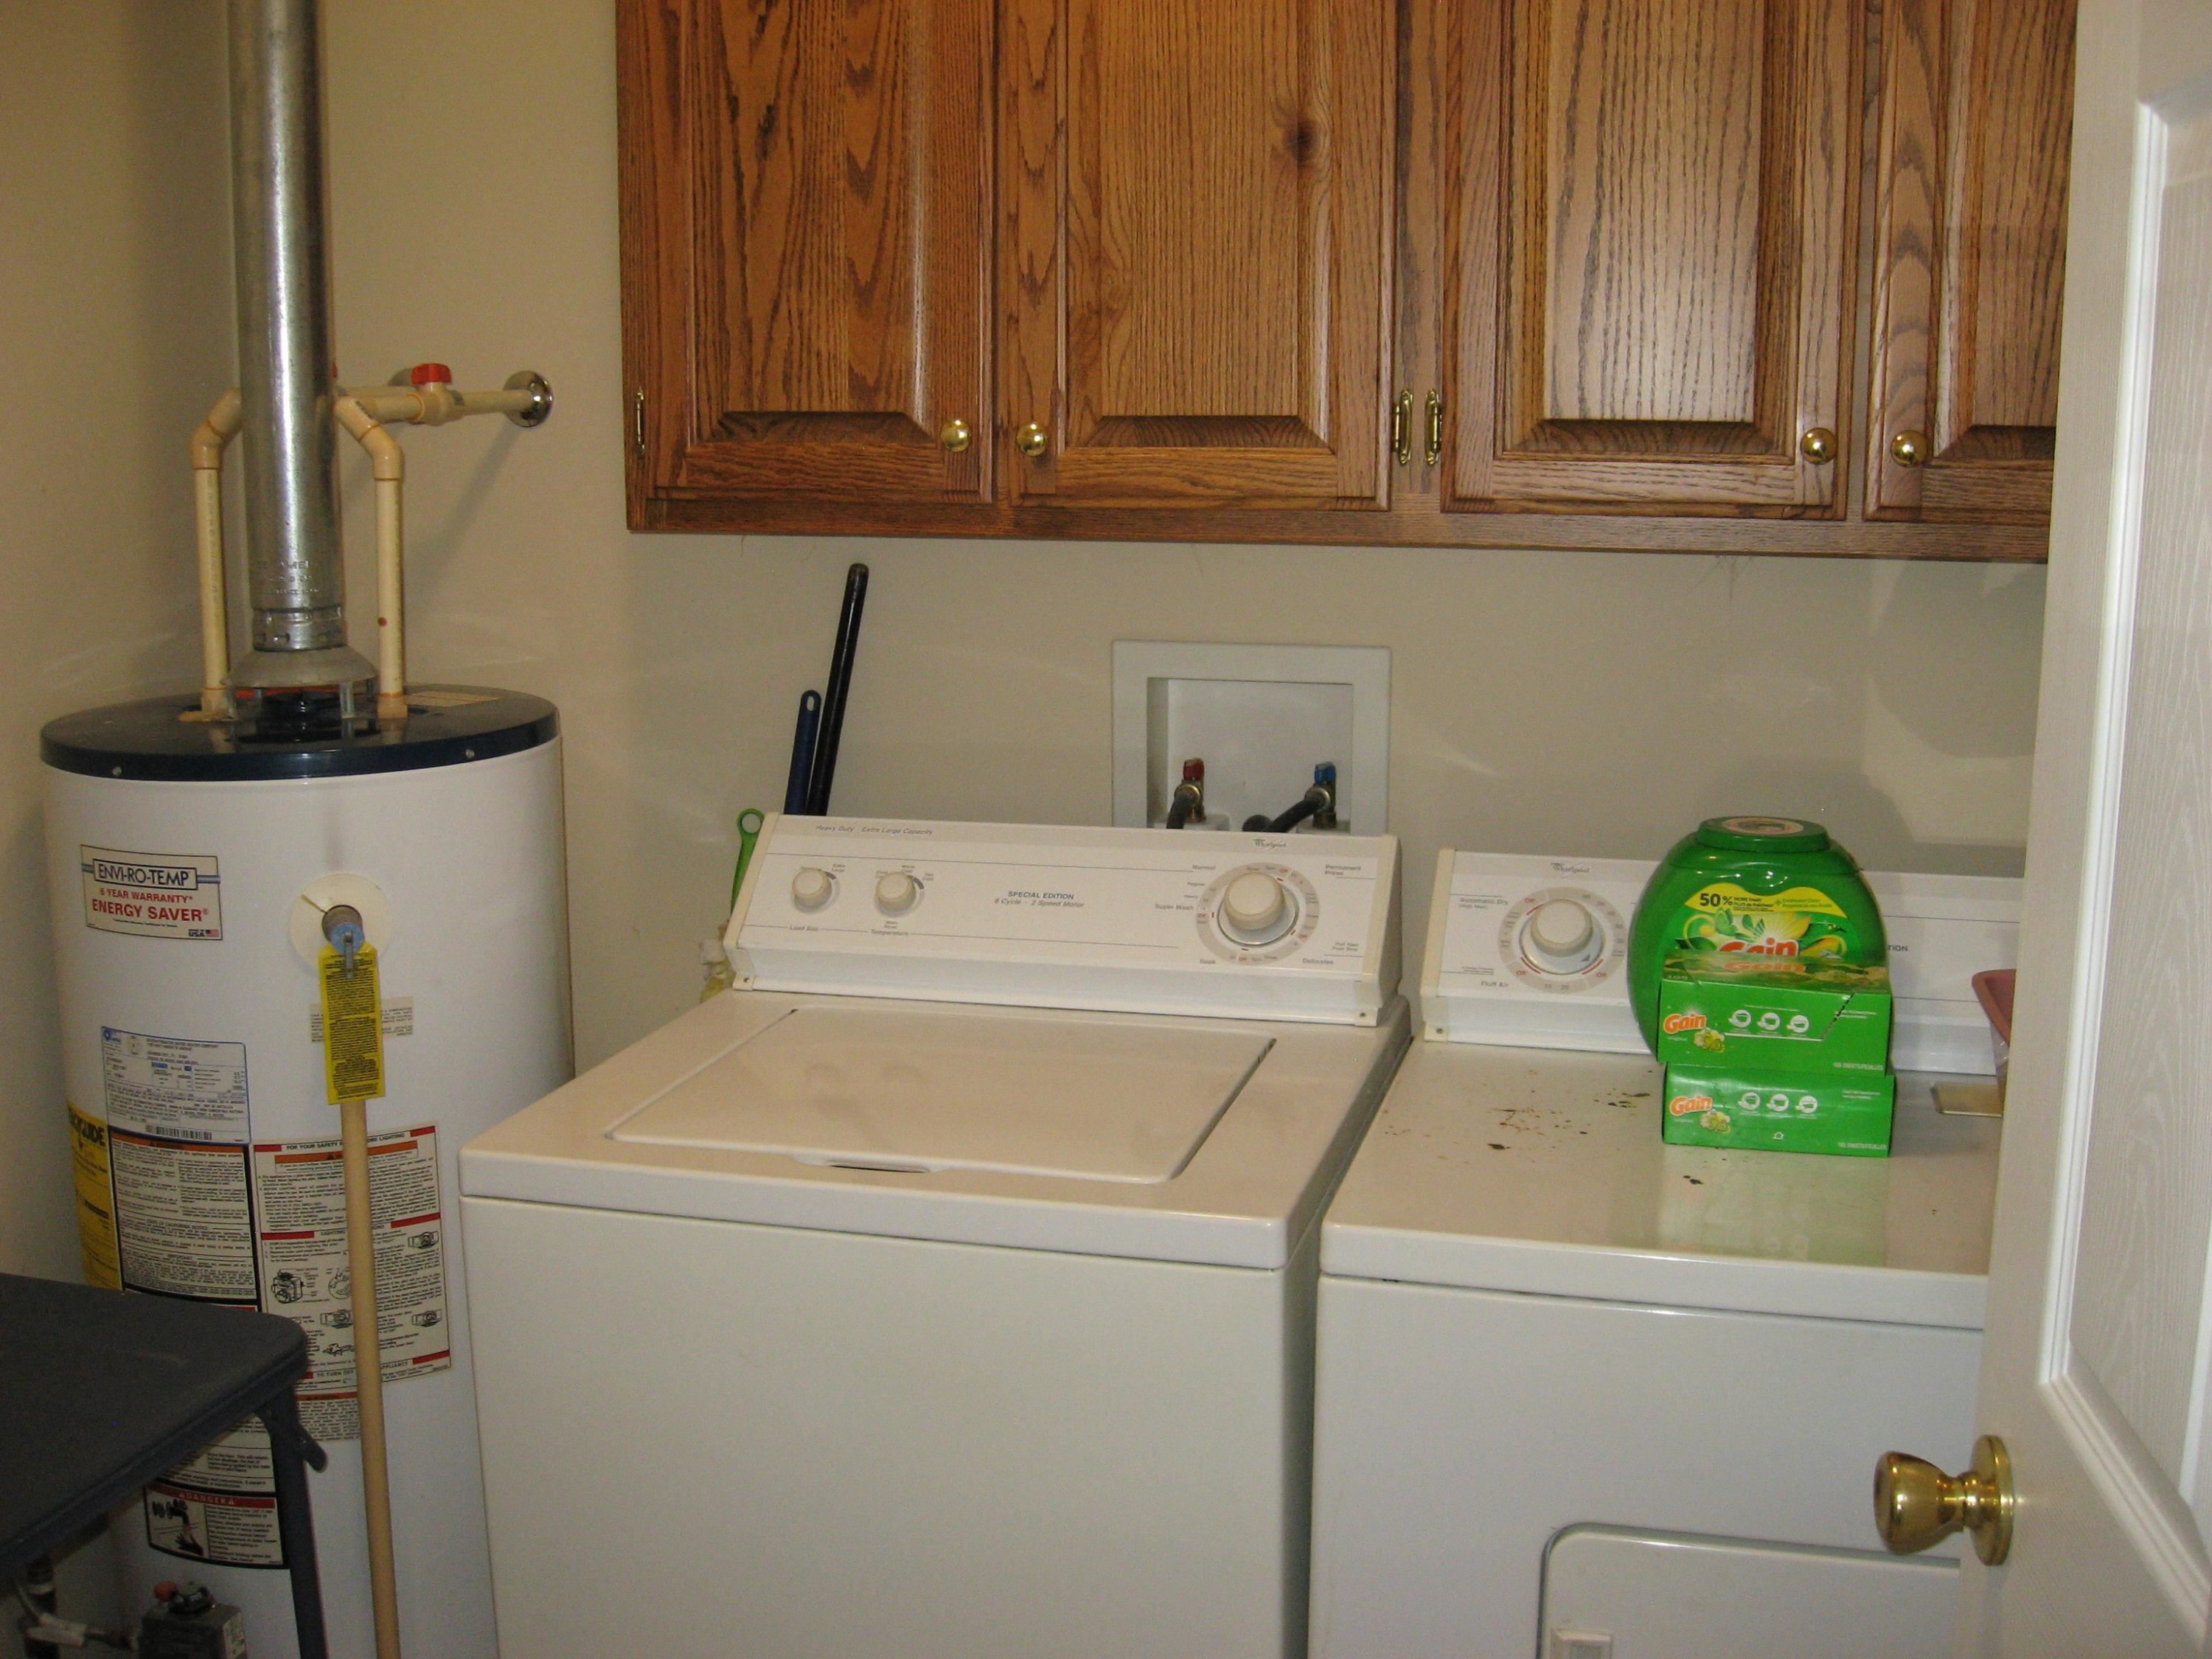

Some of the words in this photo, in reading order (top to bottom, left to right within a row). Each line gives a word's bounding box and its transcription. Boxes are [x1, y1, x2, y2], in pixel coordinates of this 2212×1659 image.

[98, 863, 189, 886] ENVI-RO-TEMP
[1551, 863, 1590, 876] Whirlpool
[106, 888, 129, 900] YEAR
[1008, 891, 1040, 899] SPECIAL
[1700, 892, 1733, 908] 50%
[92, 899, 142, 918] ENERGY
[1663, 1013, 1707, 1034] Gain
[1669, 1094, 1713, 1116] Gain
[379, 1133, 406, 1141] LIGHTING
